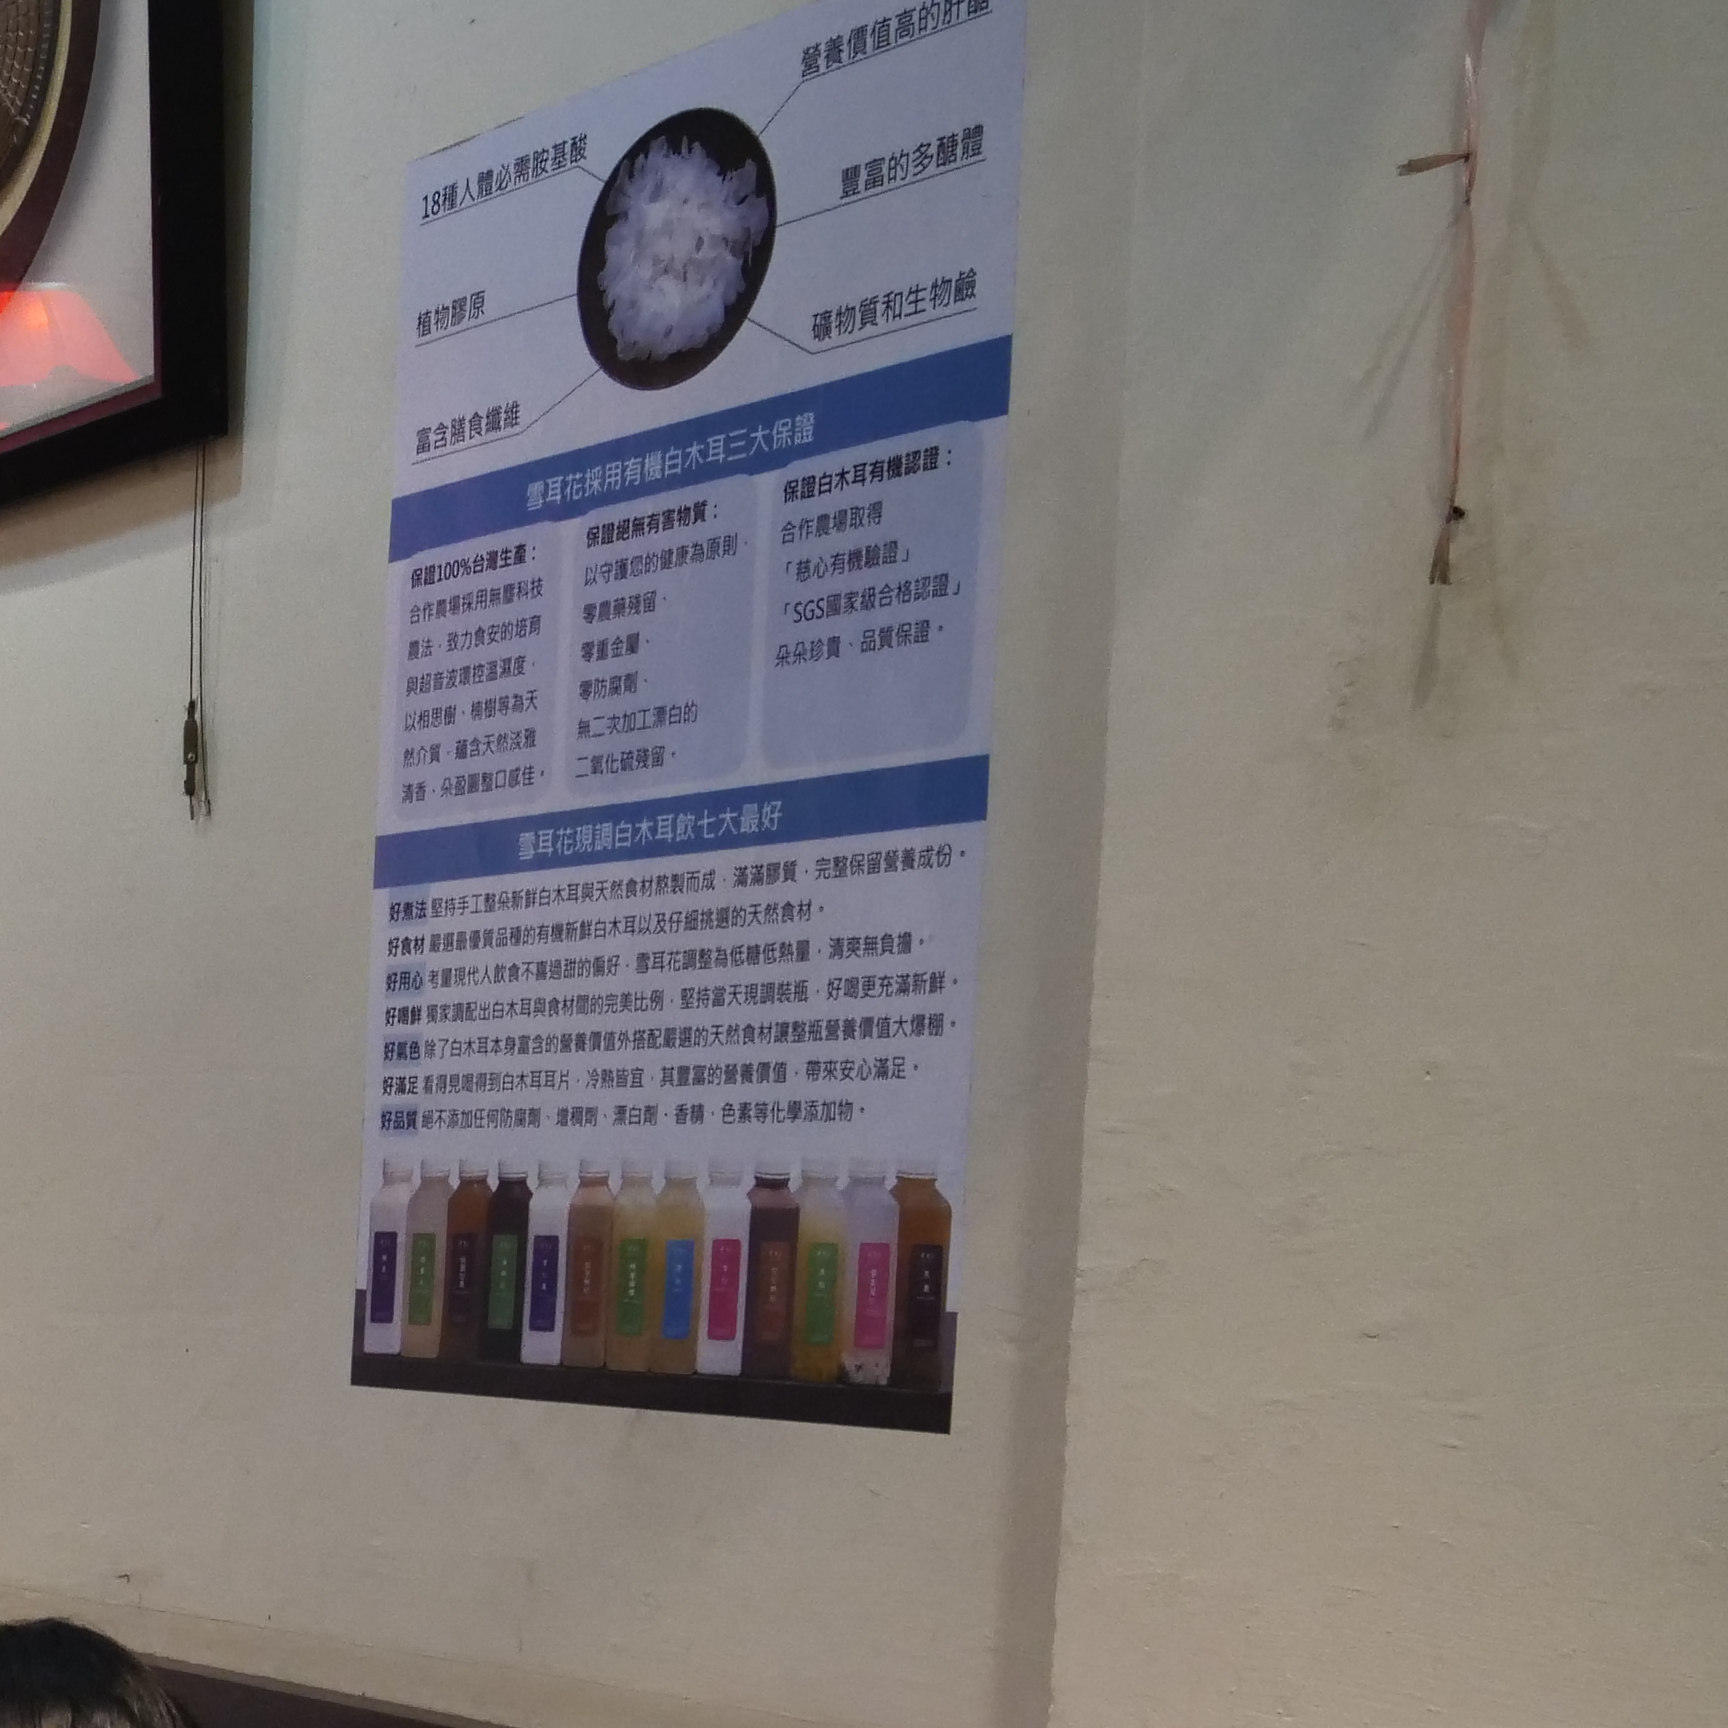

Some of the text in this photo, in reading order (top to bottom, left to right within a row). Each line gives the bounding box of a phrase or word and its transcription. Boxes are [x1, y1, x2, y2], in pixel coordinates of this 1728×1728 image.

[421, 133, 588, 219] 18種人體必需胺基酸
[839, 124, 984, 199] 豐富的多醣體
[415, 290, 486, 338] 植物膠原
[811, 267, 977, 343] 礦物質和生物鹼
[416, 400, 521, 456] 富含膳食纖維
[526, 412, 815, 511] 雪耳花採用有機白木耳三大保證
[780, 500, 884, 545] 合作農場取得
[518, 800, 783, 860] 雪耳花現調白木耳飲七大最好
[387, 933, 425, 958] 好食材
[385, 970, 424, 993] 好用心
[382, 1075, 419, 1096] 好滿足
[380, 1110, 418, 1131] 好品質
